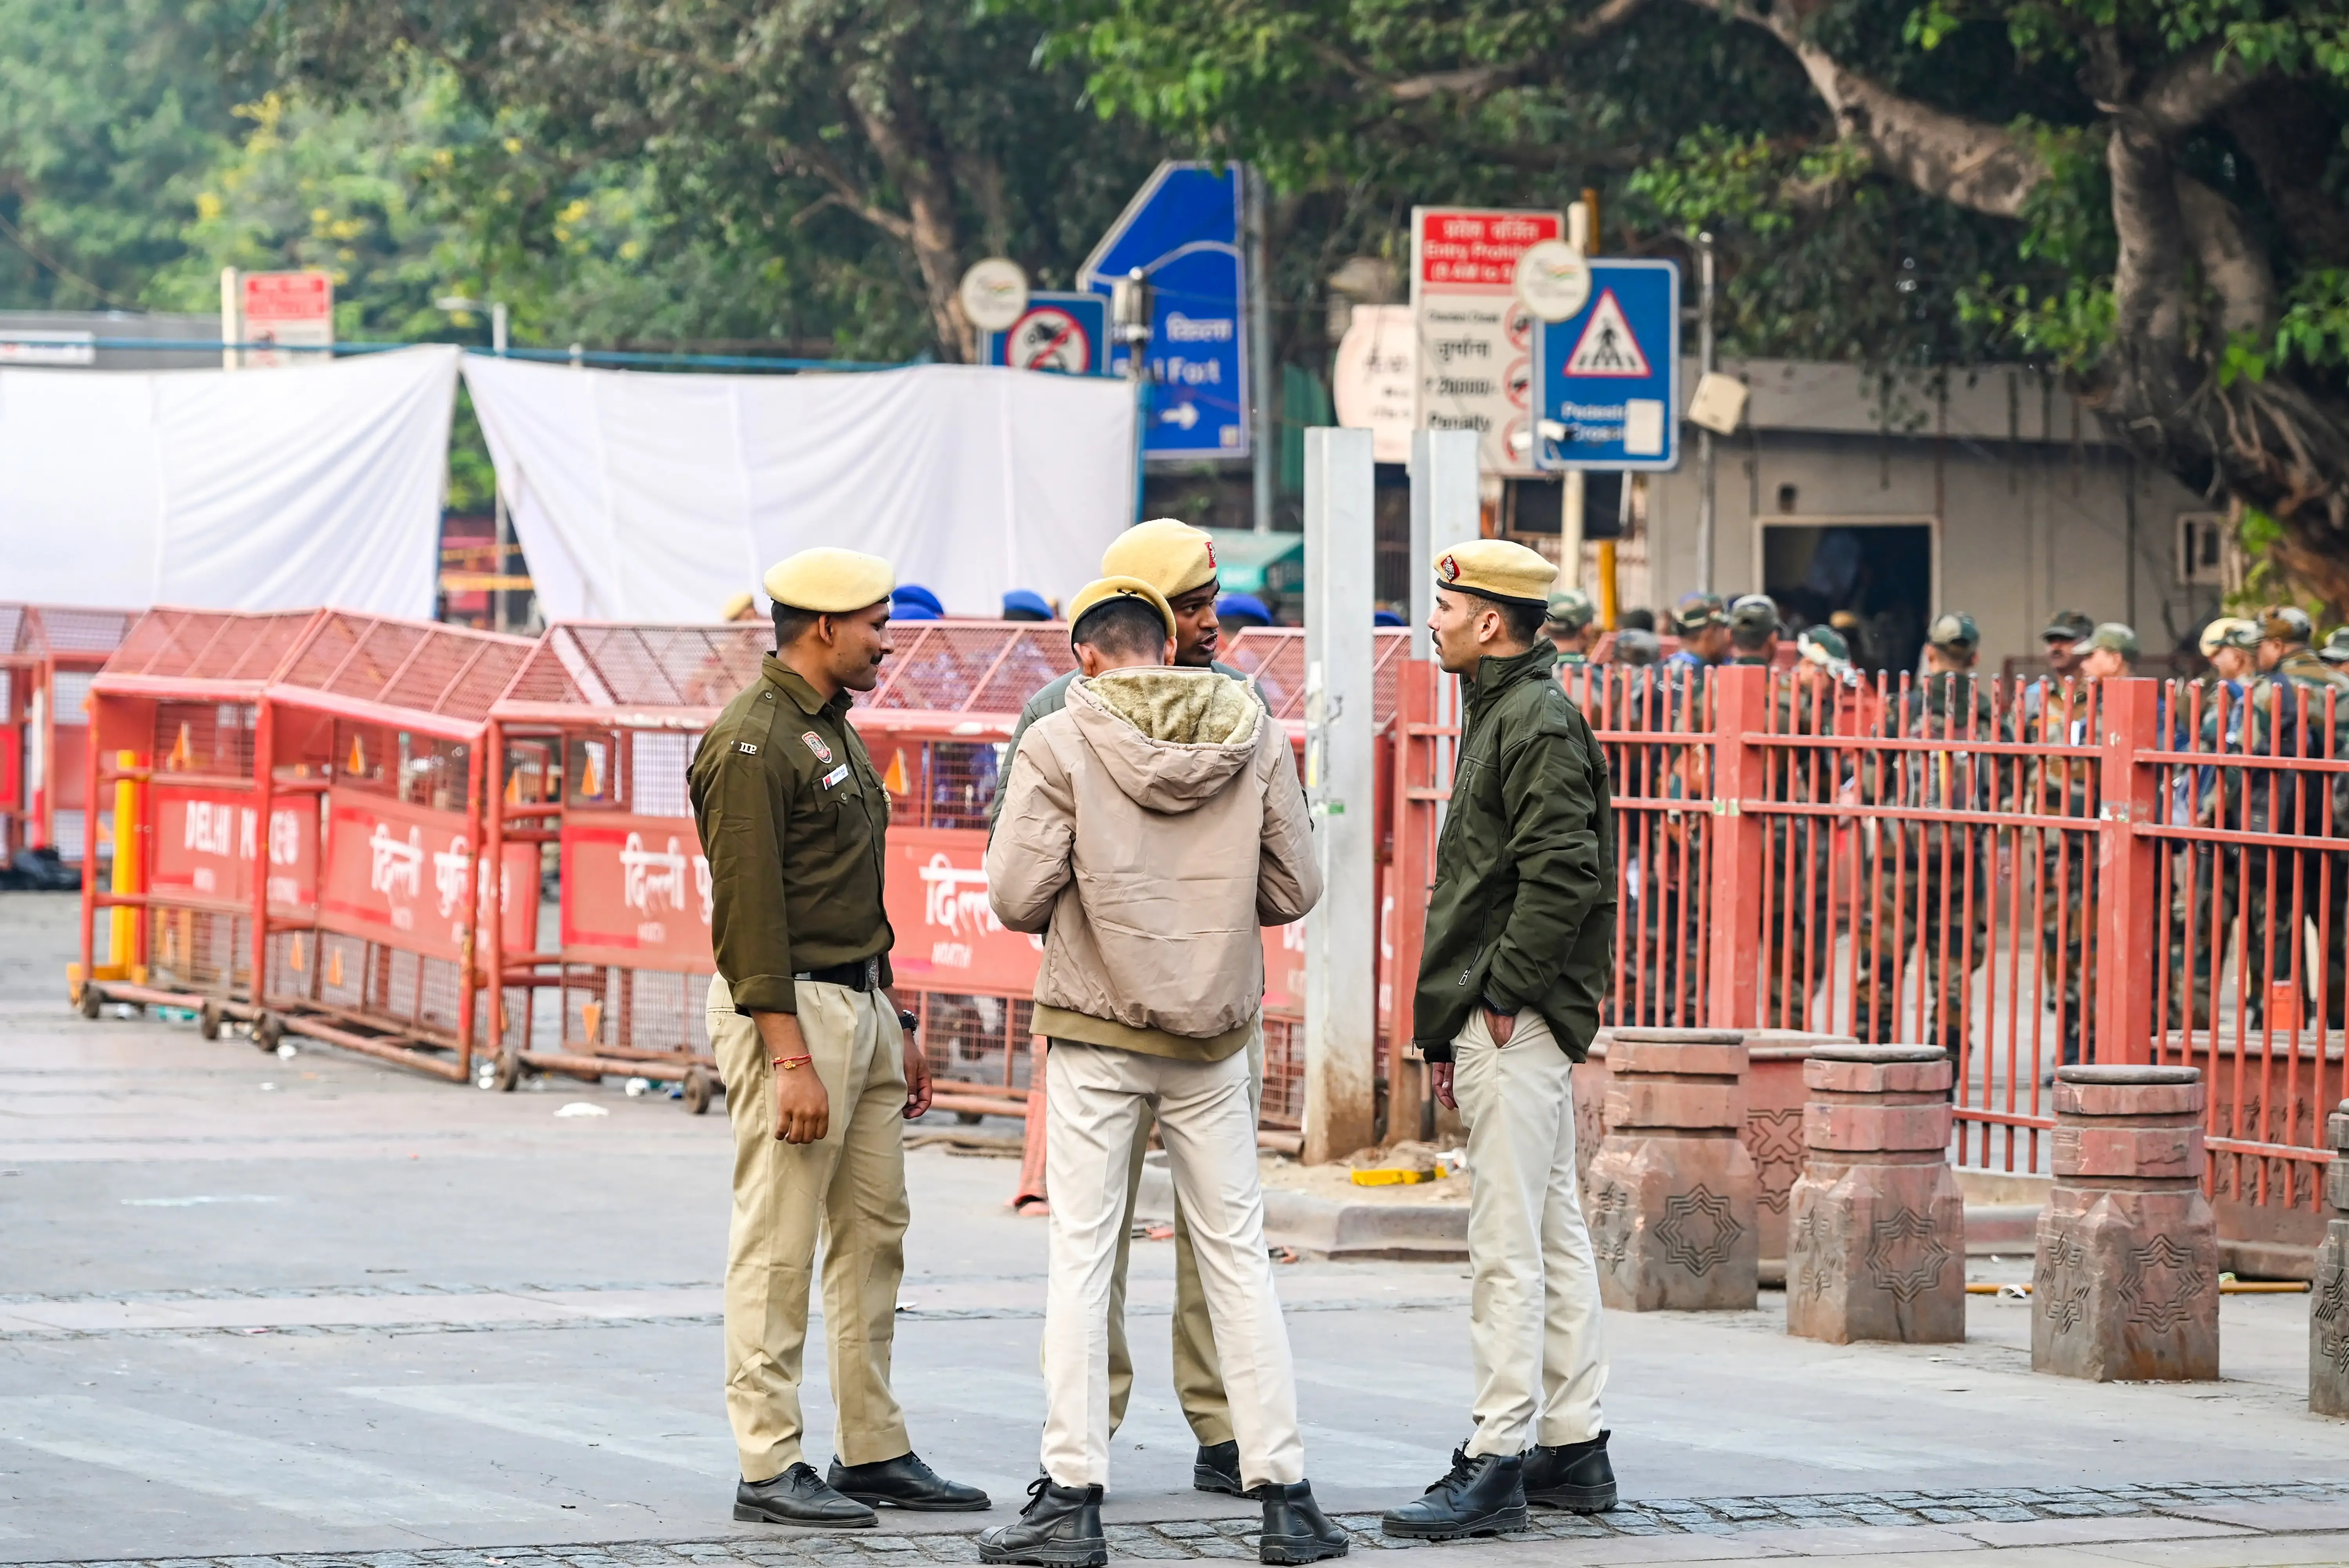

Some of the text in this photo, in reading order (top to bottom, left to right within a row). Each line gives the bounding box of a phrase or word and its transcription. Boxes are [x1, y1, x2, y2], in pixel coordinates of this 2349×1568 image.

[1424, 240, 1467, 262] Entry
[185, 800, 232, 857] DELHI
[619, 832, 687, 911] दिल्ली
[931, 941, 972, 969] NORTH
